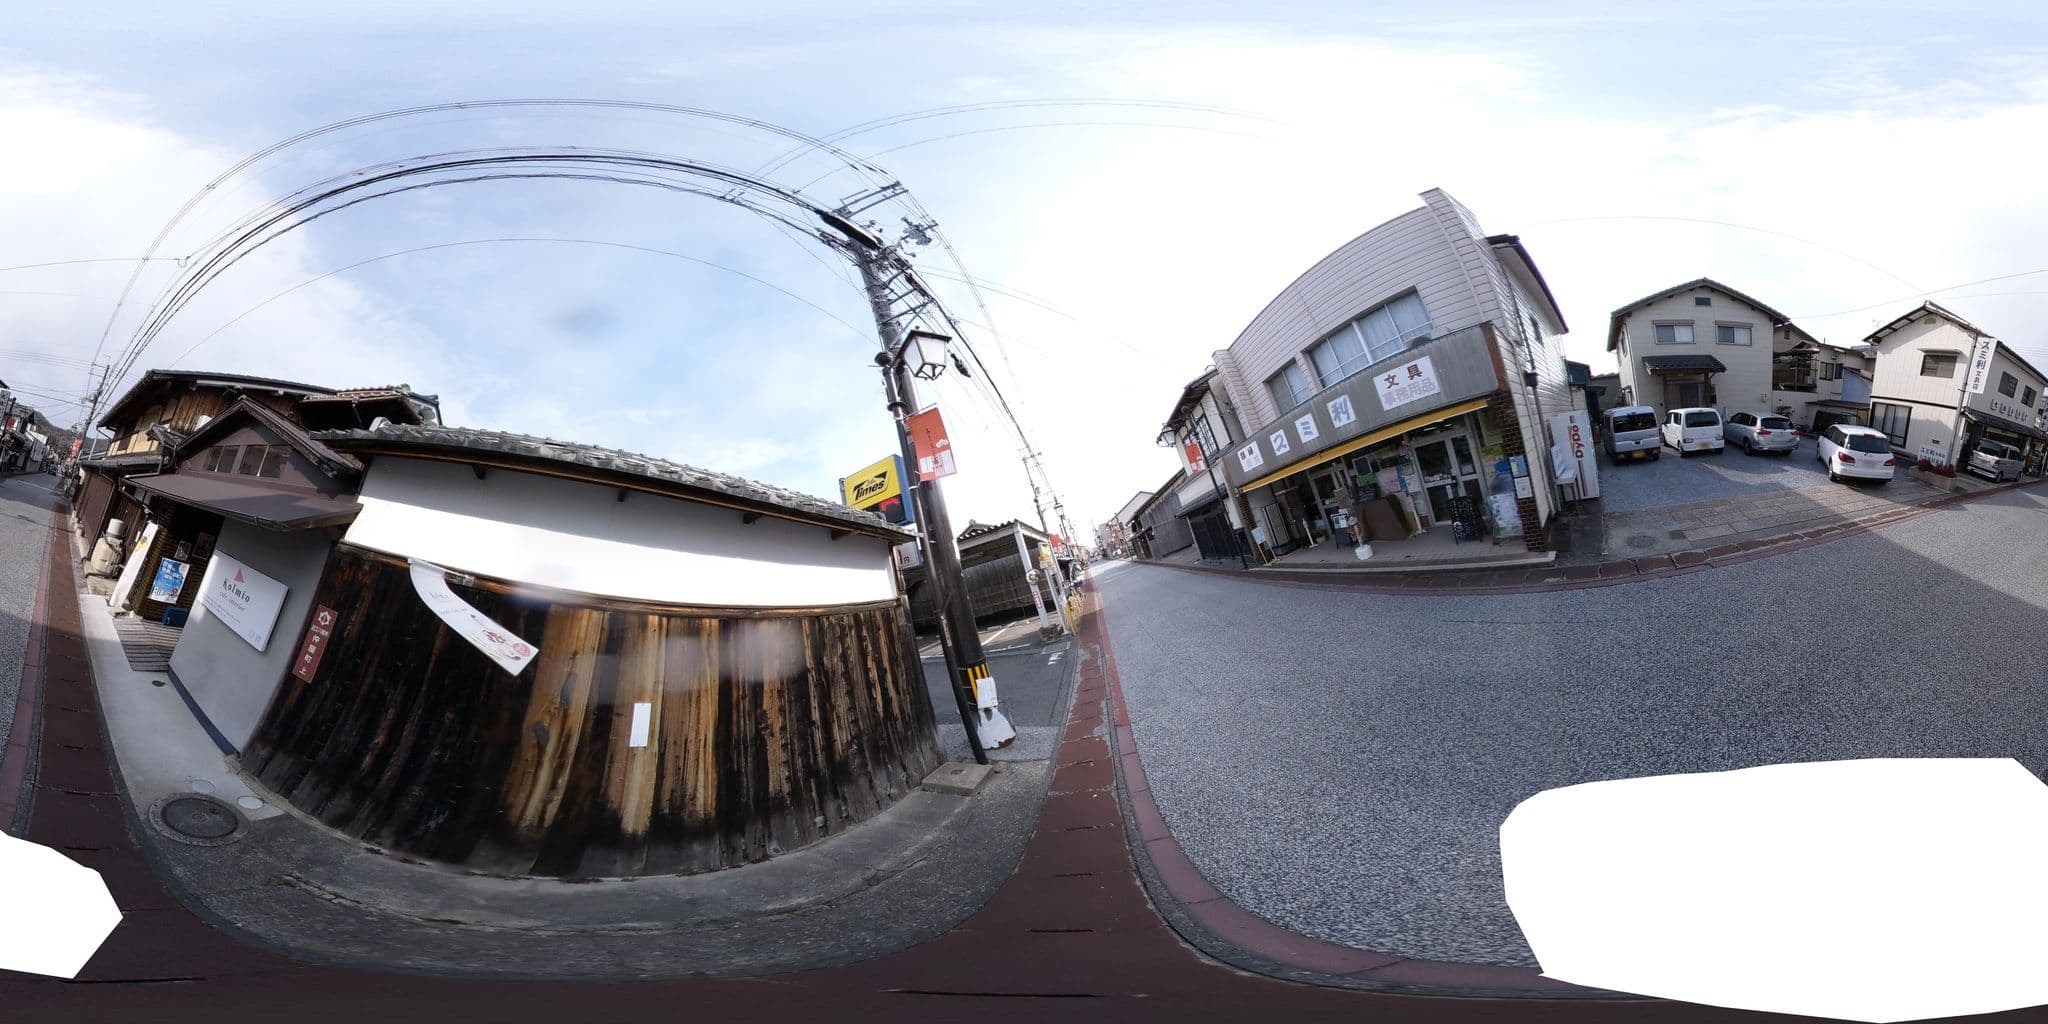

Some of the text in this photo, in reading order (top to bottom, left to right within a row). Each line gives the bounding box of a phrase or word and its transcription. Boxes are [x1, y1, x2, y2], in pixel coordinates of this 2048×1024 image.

[1384, 364, 1422, 389] 文具
[853, 474, 887, 501] Times
[222, 578, 250, 603] kolmio
